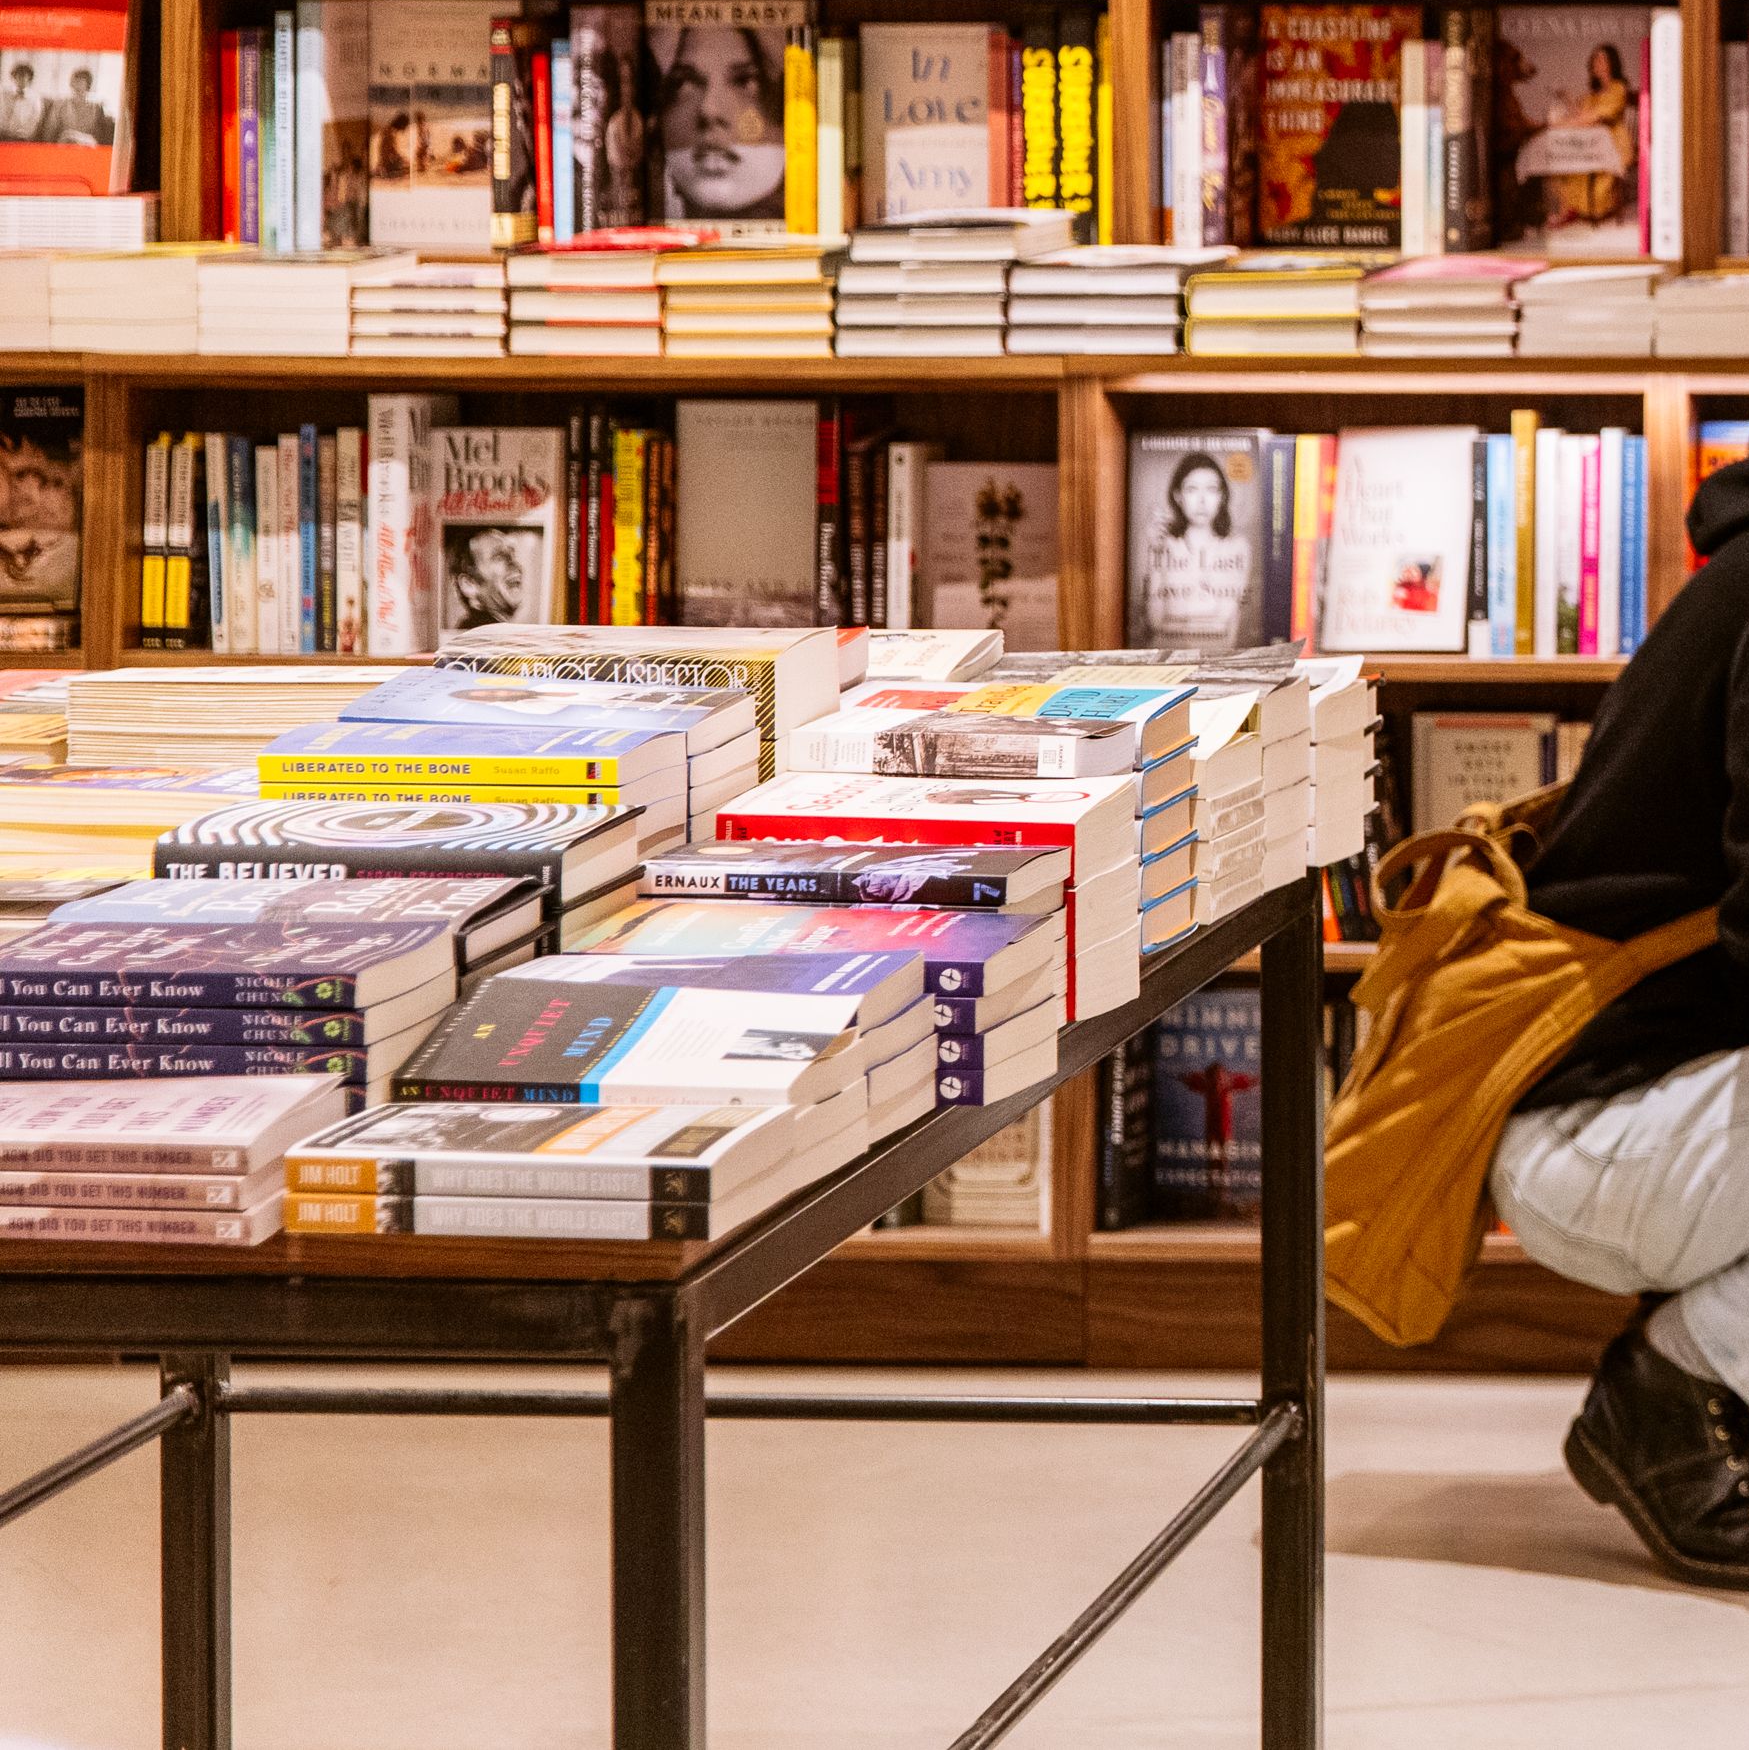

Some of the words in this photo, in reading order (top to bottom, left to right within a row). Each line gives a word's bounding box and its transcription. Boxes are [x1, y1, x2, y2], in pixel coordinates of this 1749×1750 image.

[282, 762, 373, 775] LIBERATED
[378, 762, 392, 775] TO
[395, 763, 419, 775] THE
[422, 763, 471, 775] BONE
[655, 874, 721, 890] ERNAUX
[728, 876, 762, 891] THE
[765, 875, 818, 893] YEARS
[11, 980, 48, 996] You
[53, 980, 92, 996] Can
[99, 981, 142, 997] Ever
[150, 982, 205, 998] Know
